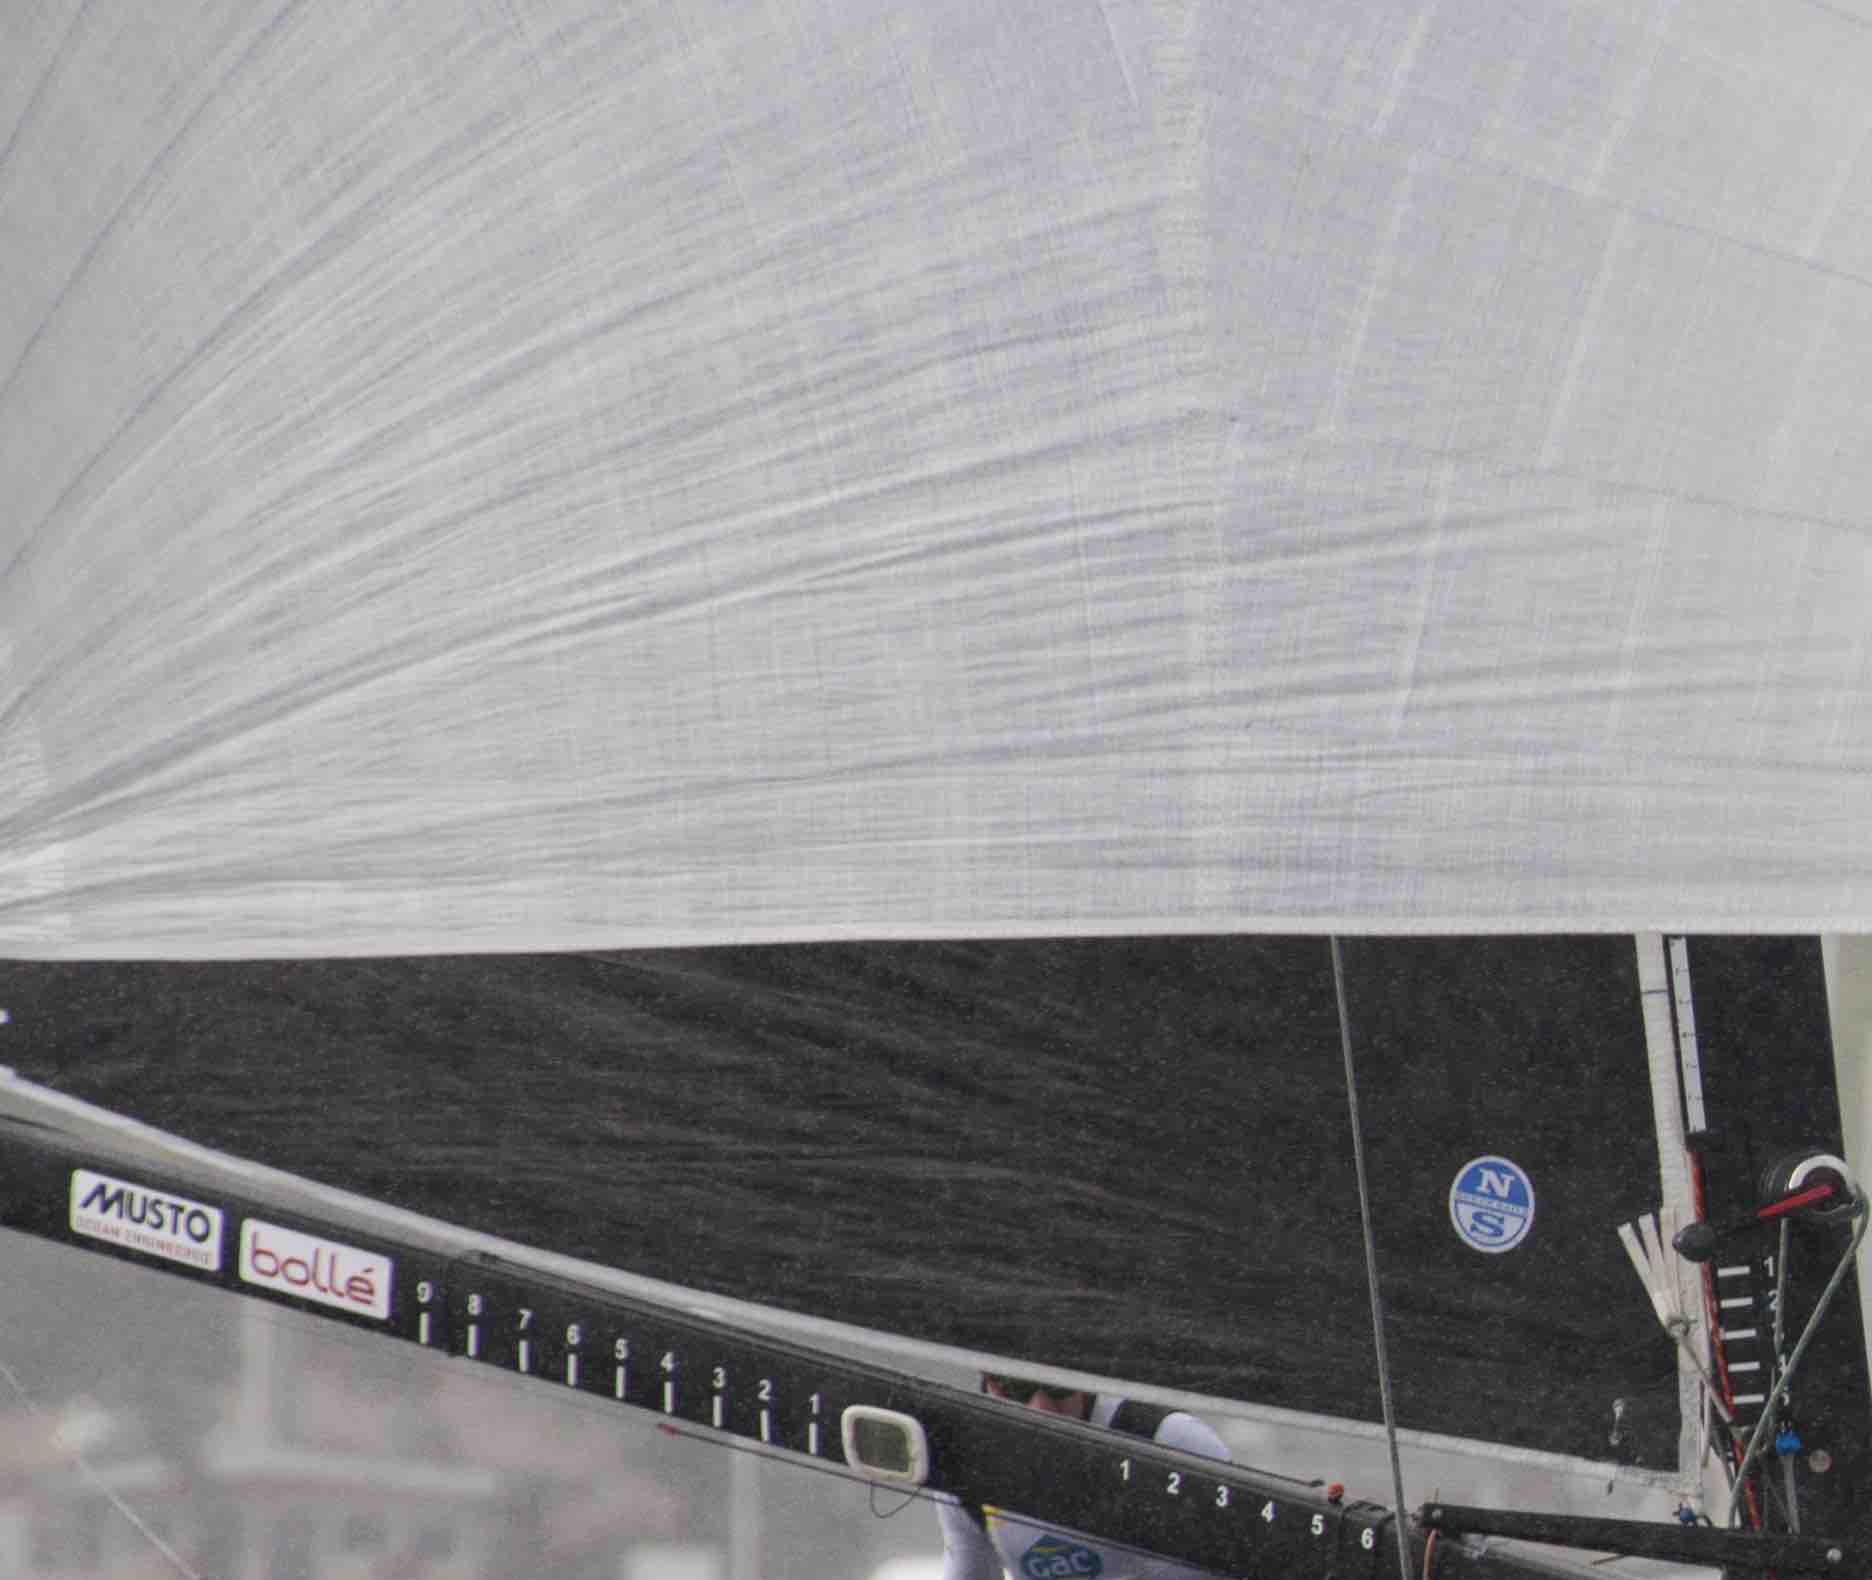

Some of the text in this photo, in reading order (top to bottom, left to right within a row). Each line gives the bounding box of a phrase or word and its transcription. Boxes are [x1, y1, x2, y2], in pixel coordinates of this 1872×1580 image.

[79, 1183, 210, 1242] MUSTO
[1475, 1168, 1515, 1199] N
[1471, 1211, 1504, 1236] S
[252, 1231, 375, 1305] bollé
[417, 1281, 820, 1414] 9 8 7 6 5 4 3 2 1
[1120, 1460, 1374, 1550] 1 2 3 4 5 6
